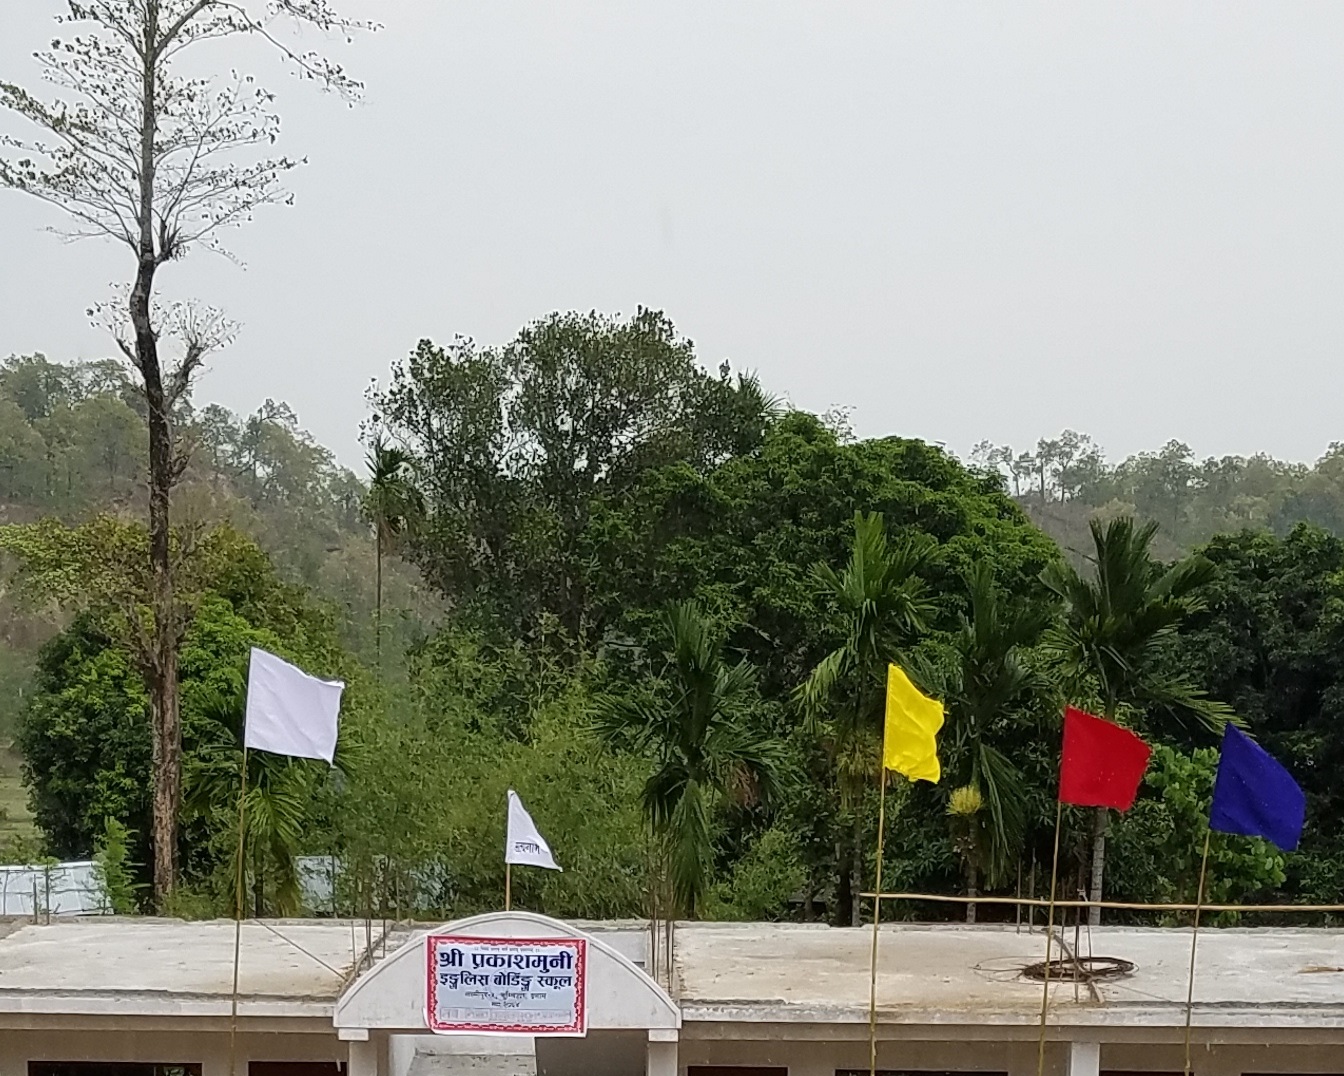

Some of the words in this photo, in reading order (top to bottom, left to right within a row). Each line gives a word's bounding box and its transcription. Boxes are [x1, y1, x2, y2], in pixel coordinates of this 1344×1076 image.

[439, 948, 464, 967] श्री
[471, 951, 573, 973] प्रकाशमुनी
[537, 975, 572, 990] स्कूल
